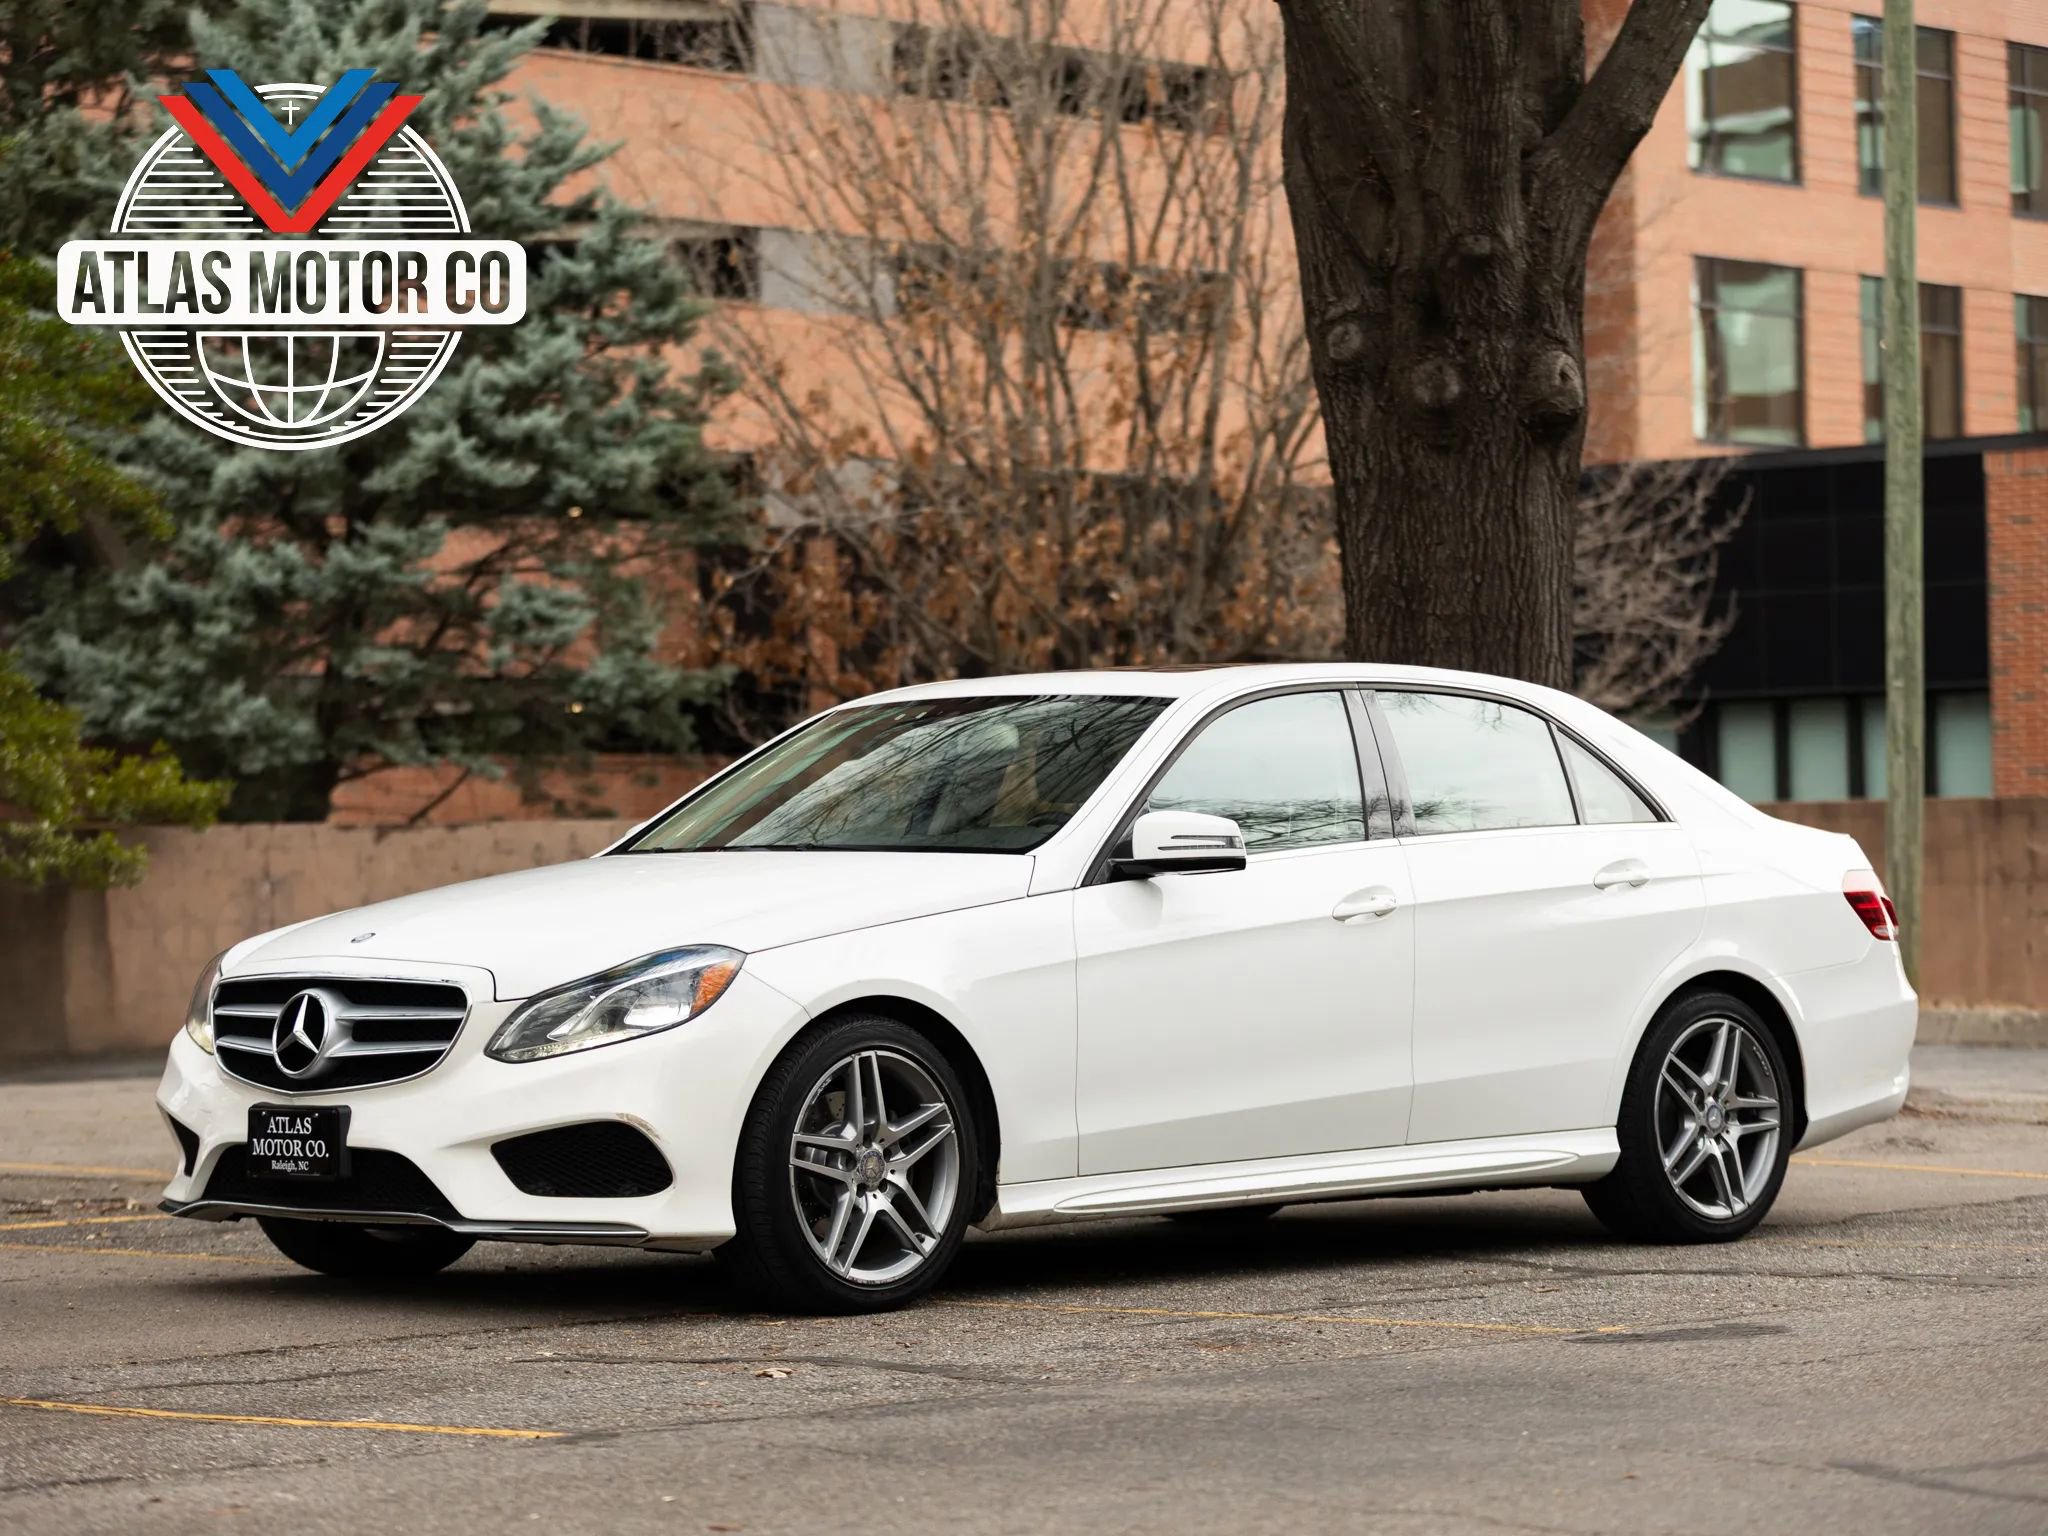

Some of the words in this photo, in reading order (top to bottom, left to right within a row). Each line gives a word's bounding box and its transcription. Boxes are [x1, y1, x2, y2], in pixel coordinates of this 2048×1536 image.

[267, 1116, 312, 1134] ATLAS
[252, 1138, 303, 1157] MOTOR
[305, 1140, 329, 1158] CO.
[271, 1160, 297, 1172] Raleigh,
[298, 1161, 309, 1171] NC
